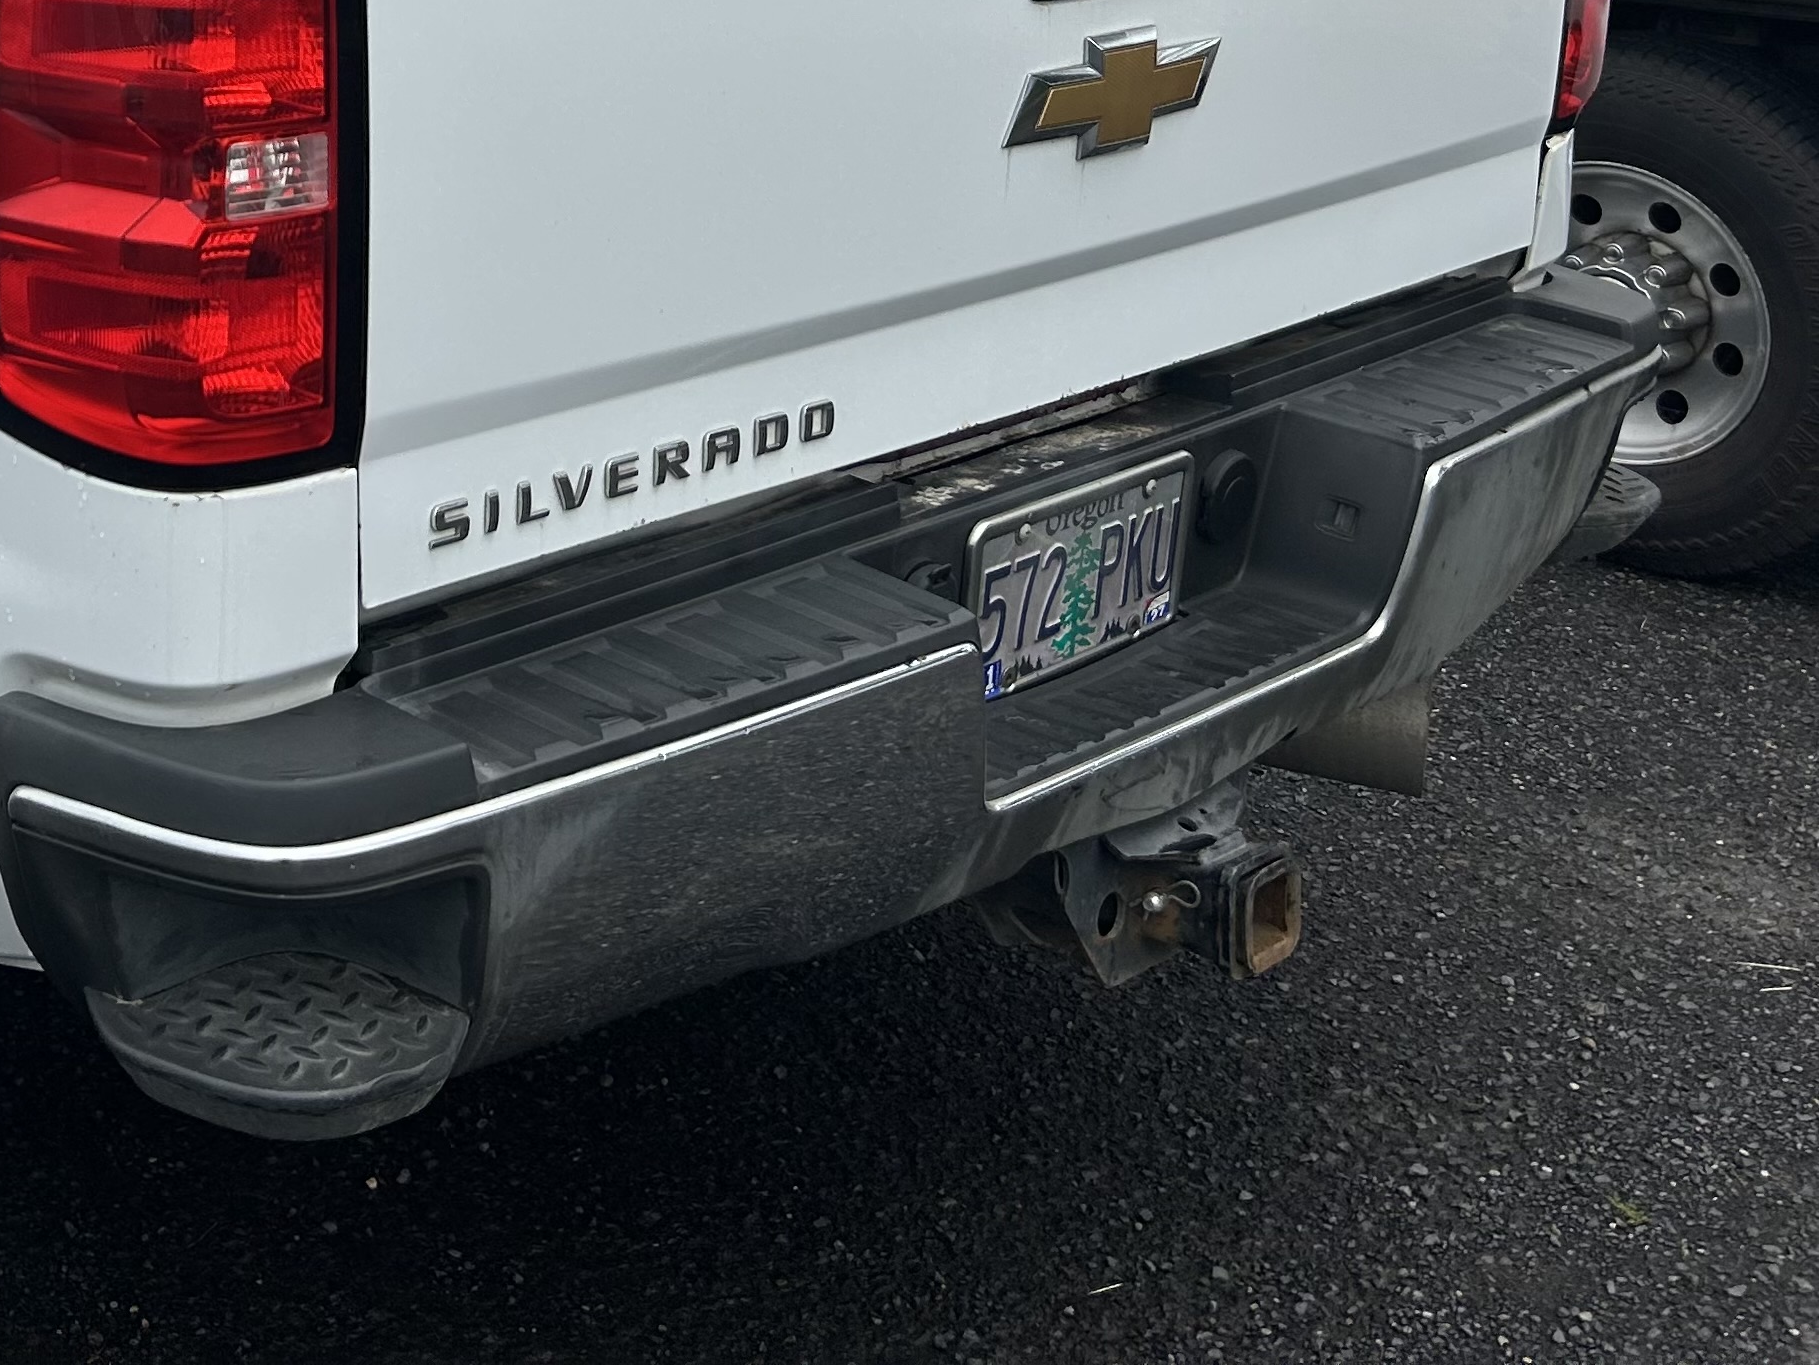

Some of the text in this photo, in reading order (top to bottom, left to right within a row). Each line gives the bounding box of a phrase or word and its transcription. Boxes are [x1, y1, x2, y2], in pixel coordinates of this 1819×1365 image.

[428, 399, 835, 550] SILVERADO
[1045, 493, 1124, 536] Oregon
[981, 497, 1180, 663] 572 PKU
